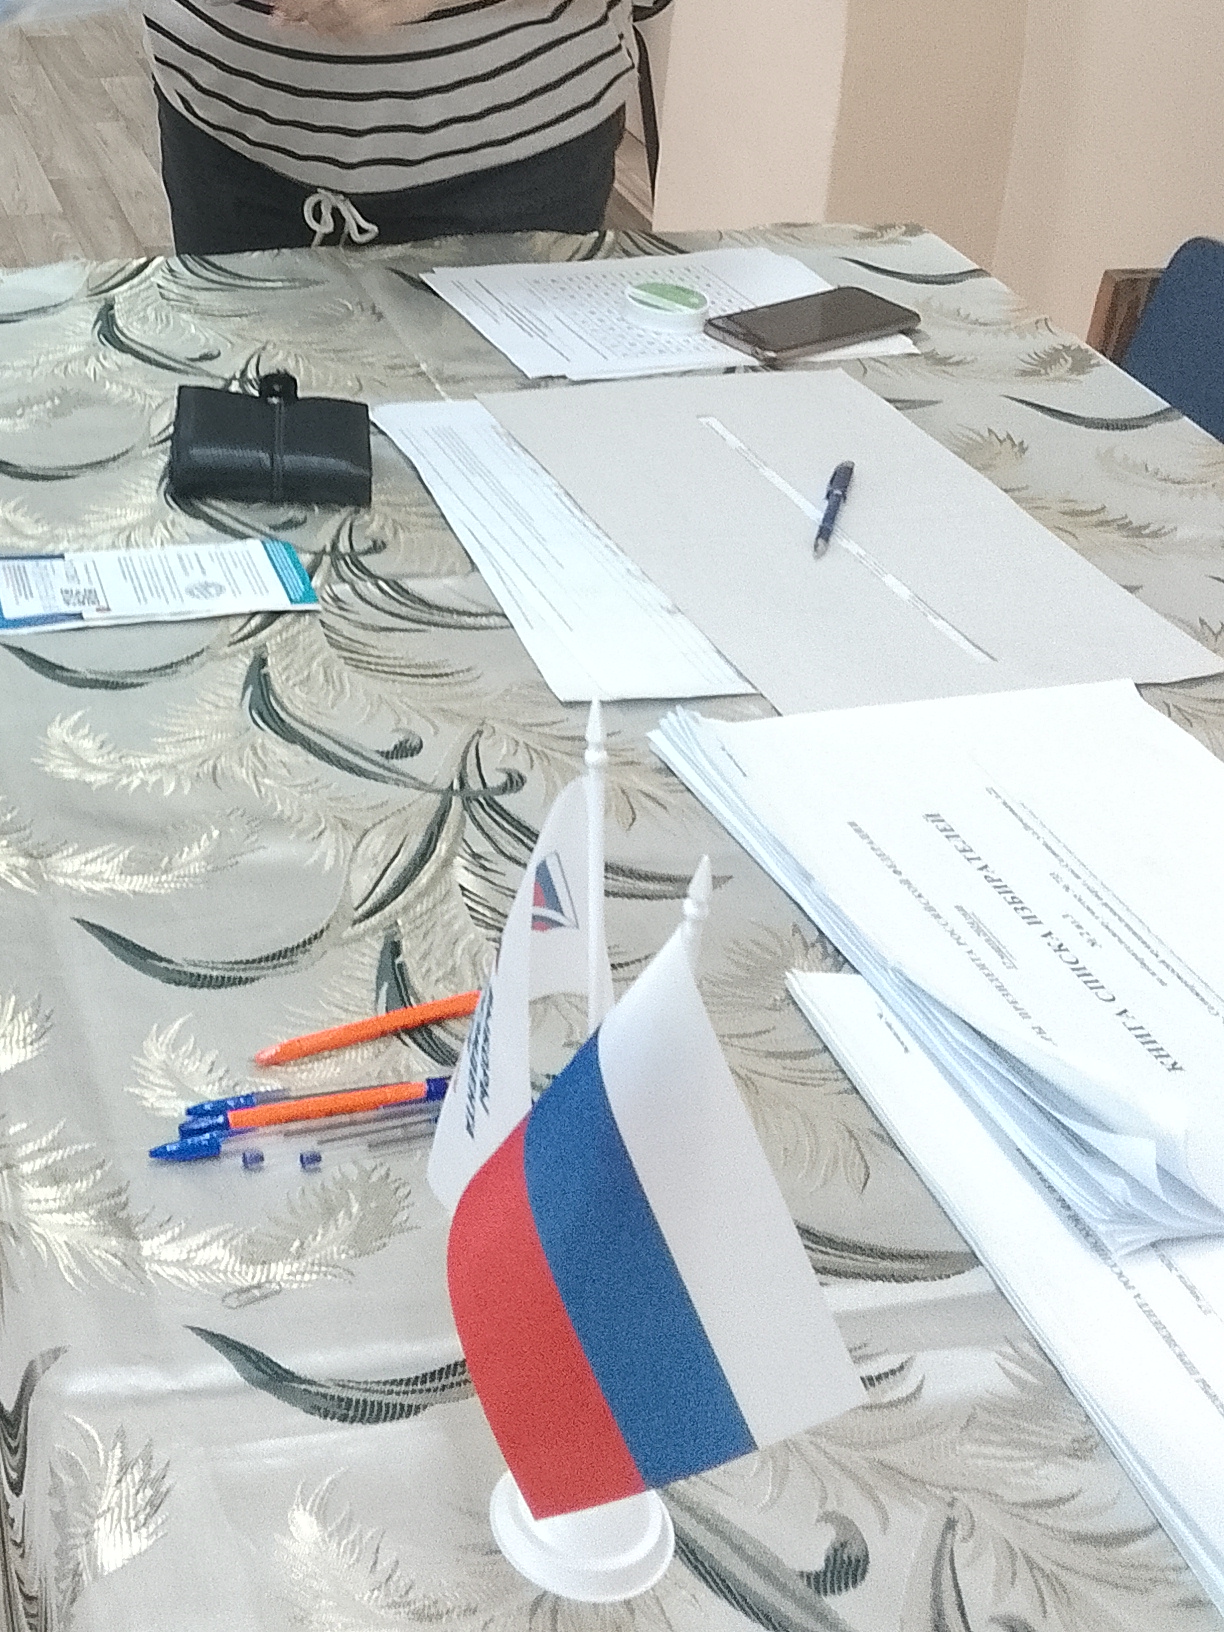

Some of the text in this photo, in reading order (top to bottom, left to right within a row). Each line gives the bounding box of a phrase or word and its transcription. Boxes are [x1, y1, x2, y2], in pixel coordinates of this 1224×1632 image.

[922, 812, 1044, 926] ИЗБИРАТЕЛЕЙ
[1041, 930, 1116, 1003] СПИСКА
[1113, 1008, 1186, 1074] КНИГА
